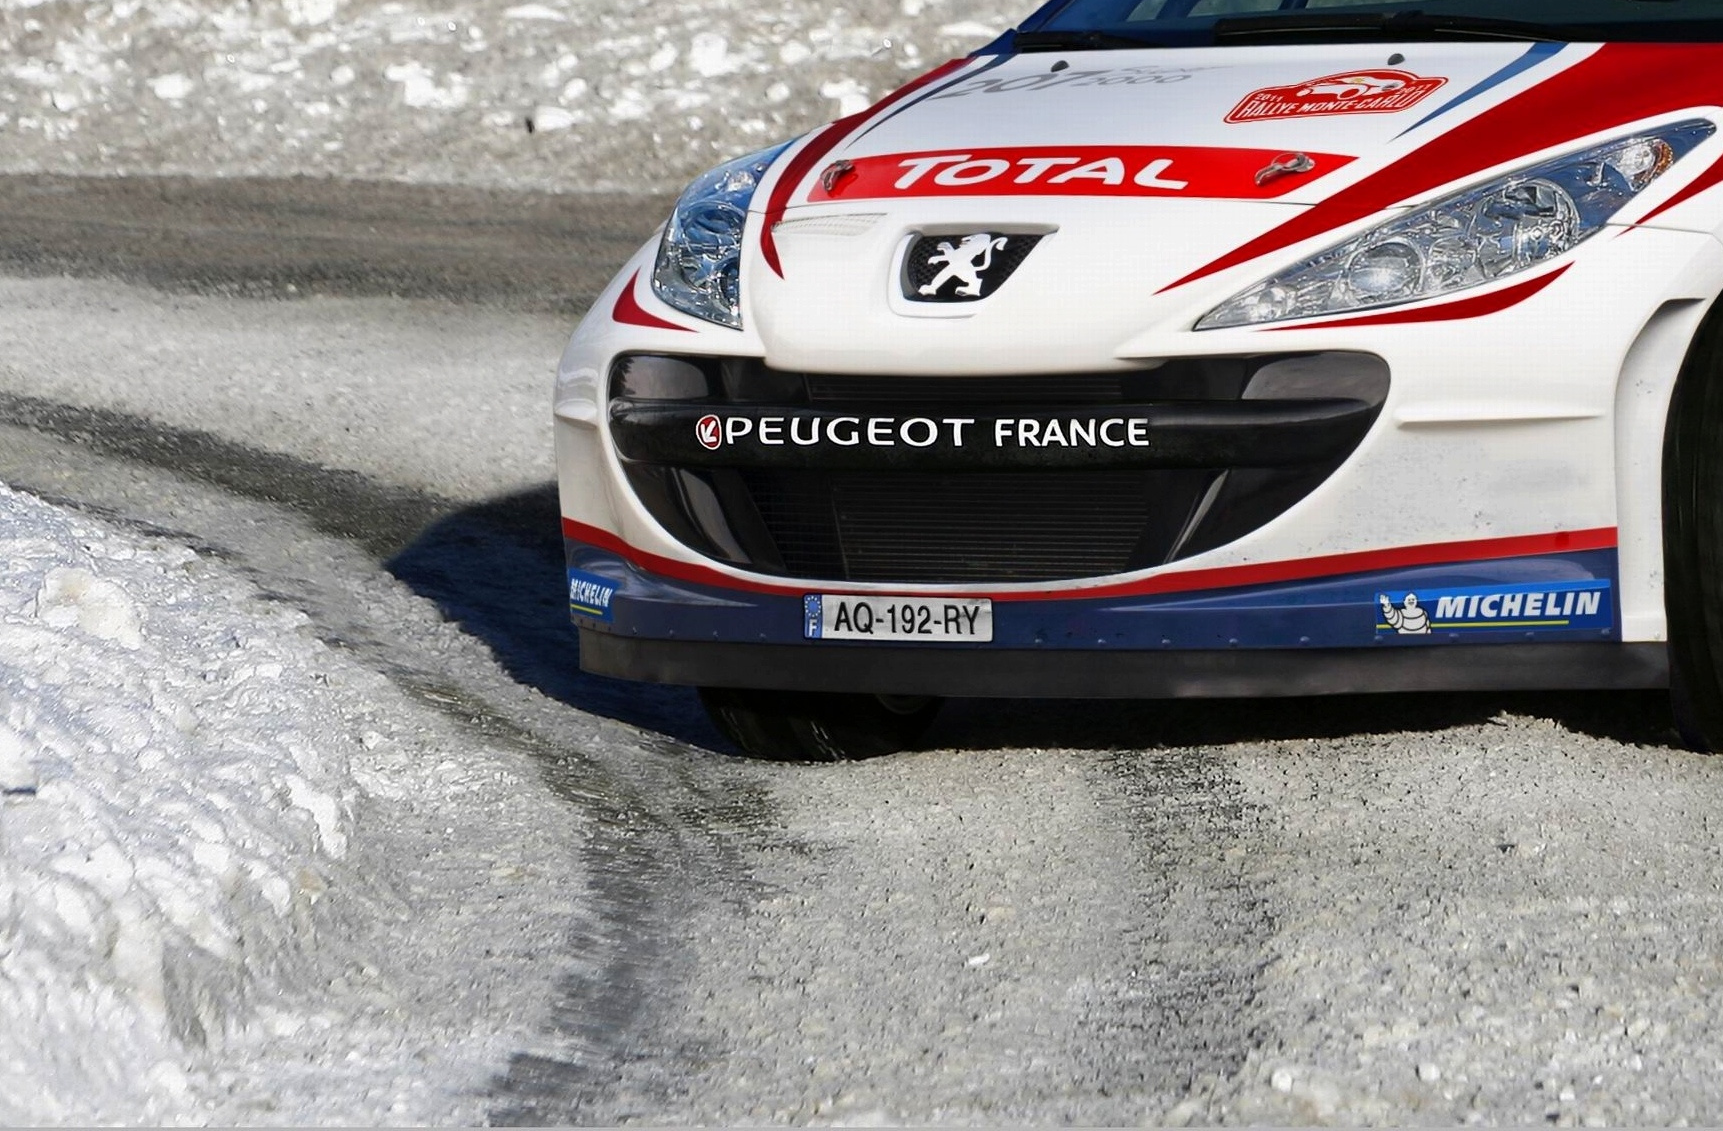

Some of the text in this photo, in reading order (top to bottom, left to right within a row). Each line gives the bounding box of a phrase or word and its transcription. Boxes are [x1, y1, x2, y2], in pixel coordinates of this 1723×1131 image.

[1235, 99, 1300, 119] RALLYE
[893, 153, 1190, 191] TOTAL
[725, 416, 1150, 448] PEUGEOT FRANCE
[569, 577, 614, 608] MICHELIN
[1434, 590, 1601, 620] MICHELIN
[808, 618, 818, 638] F
[833, 601, 981, 636] AQ-192-RY
